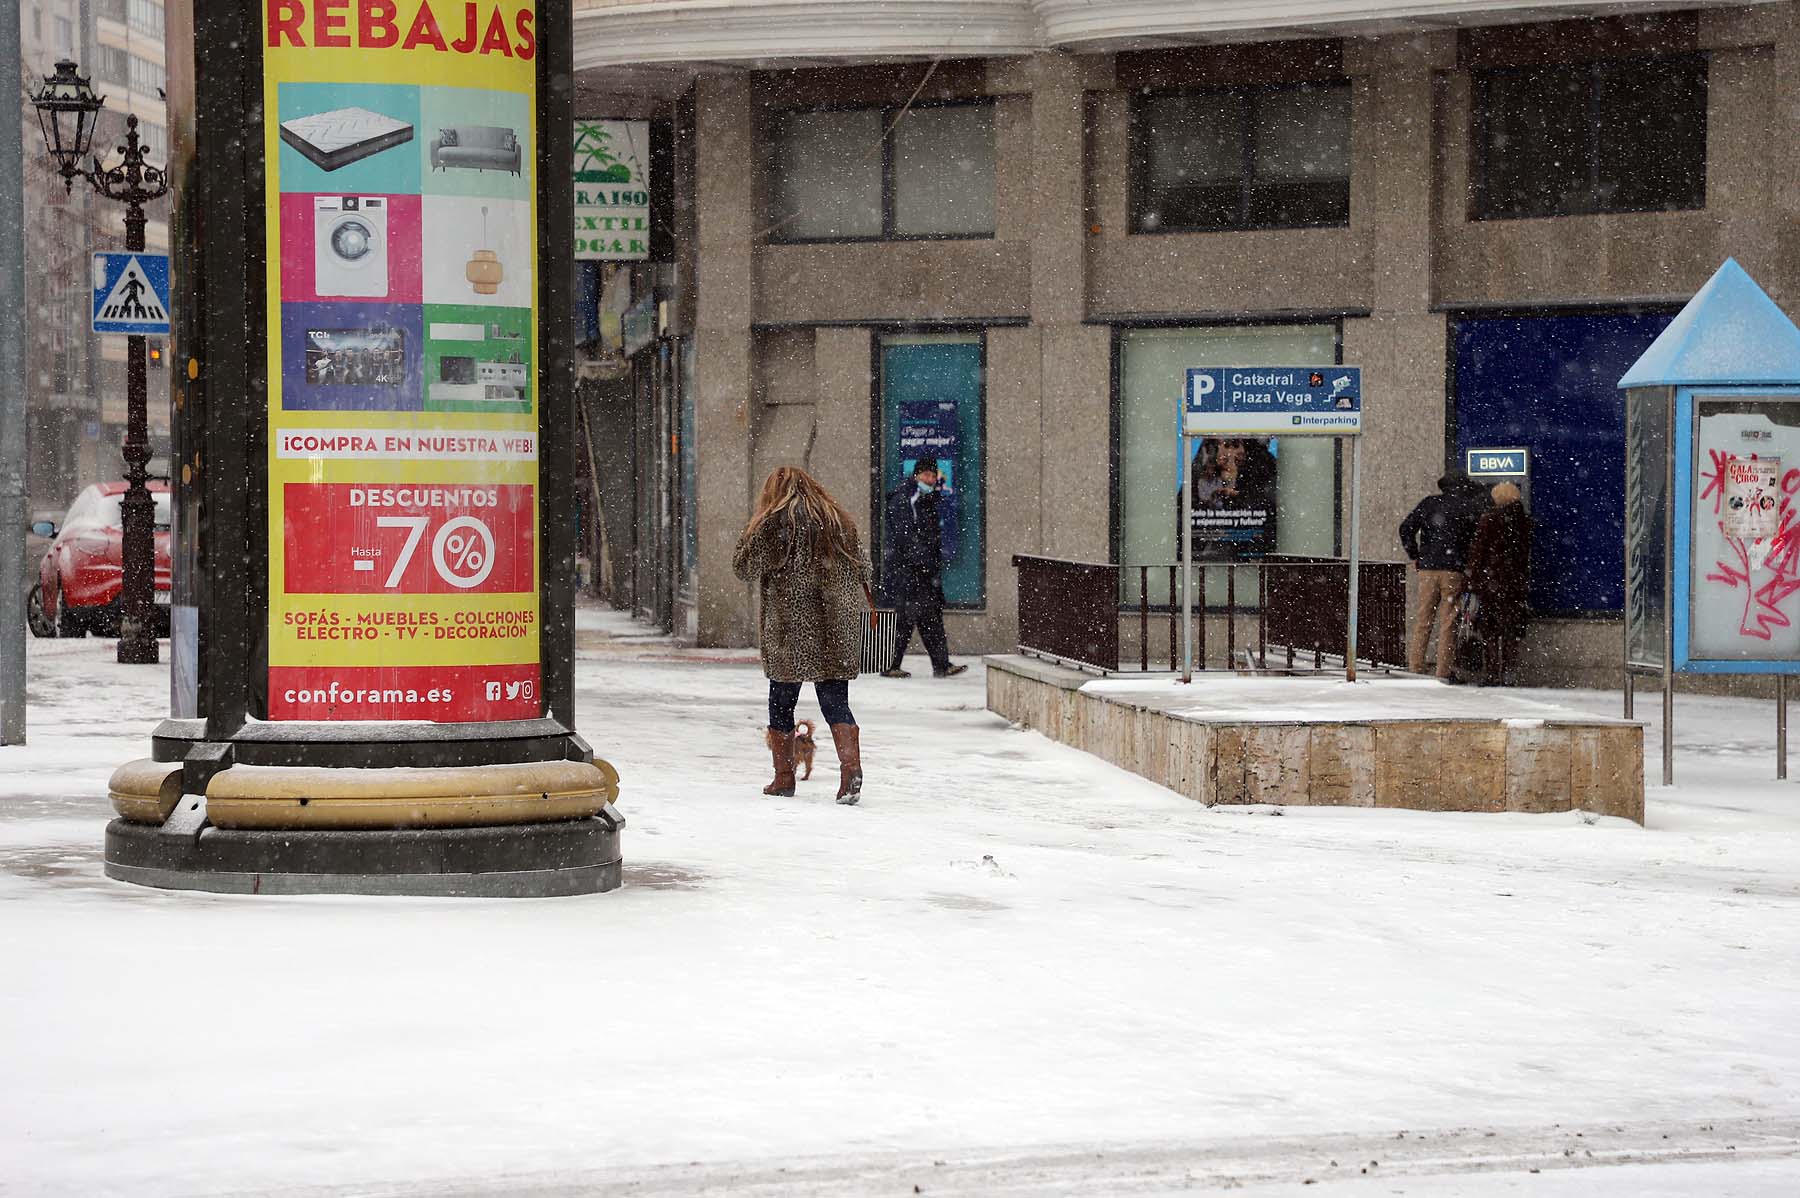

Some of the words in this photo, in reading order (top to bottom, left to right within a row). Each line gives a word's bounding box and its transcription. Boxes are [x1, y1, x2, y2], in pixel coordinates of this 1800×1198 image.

[267, 0, 535, 60] REBAJAS
[575, 190, 648, 206] RAISO
[575, 216, 647, 230] XTIL
[574, 239, 647, 253] OGAR
[1232, 373, 1294, 386] Catedral
[1193, 374, 1215, 406] P
[1232, 391, 1271, 404] Plaza
[1276, 391, 1312, 406] Vega
[1303, 415, 1358, 426] Interparking
[284, 436, 377, 451] ¡COMPRA
[385, 437, 411, 451] EN
[417, 437, 497, 453] NUESTRA
[502, 438, 533, 453] WEB!
[1480, 456, 1514, 469] BBVA
[350, 489, 497, 507] DESCUENTOS
[351, 547, 381, 557] Hasta
[284, 609, 339, 625] SOFÁS
[357, 612, 438, 625] MUEBLES
[454, 611, 534, 624] COLCHONES
[297, 627, 378, 640] ELECTRO
[395, 627, 418, 640] TV
[284, 682, 453, 704] conforama.es
